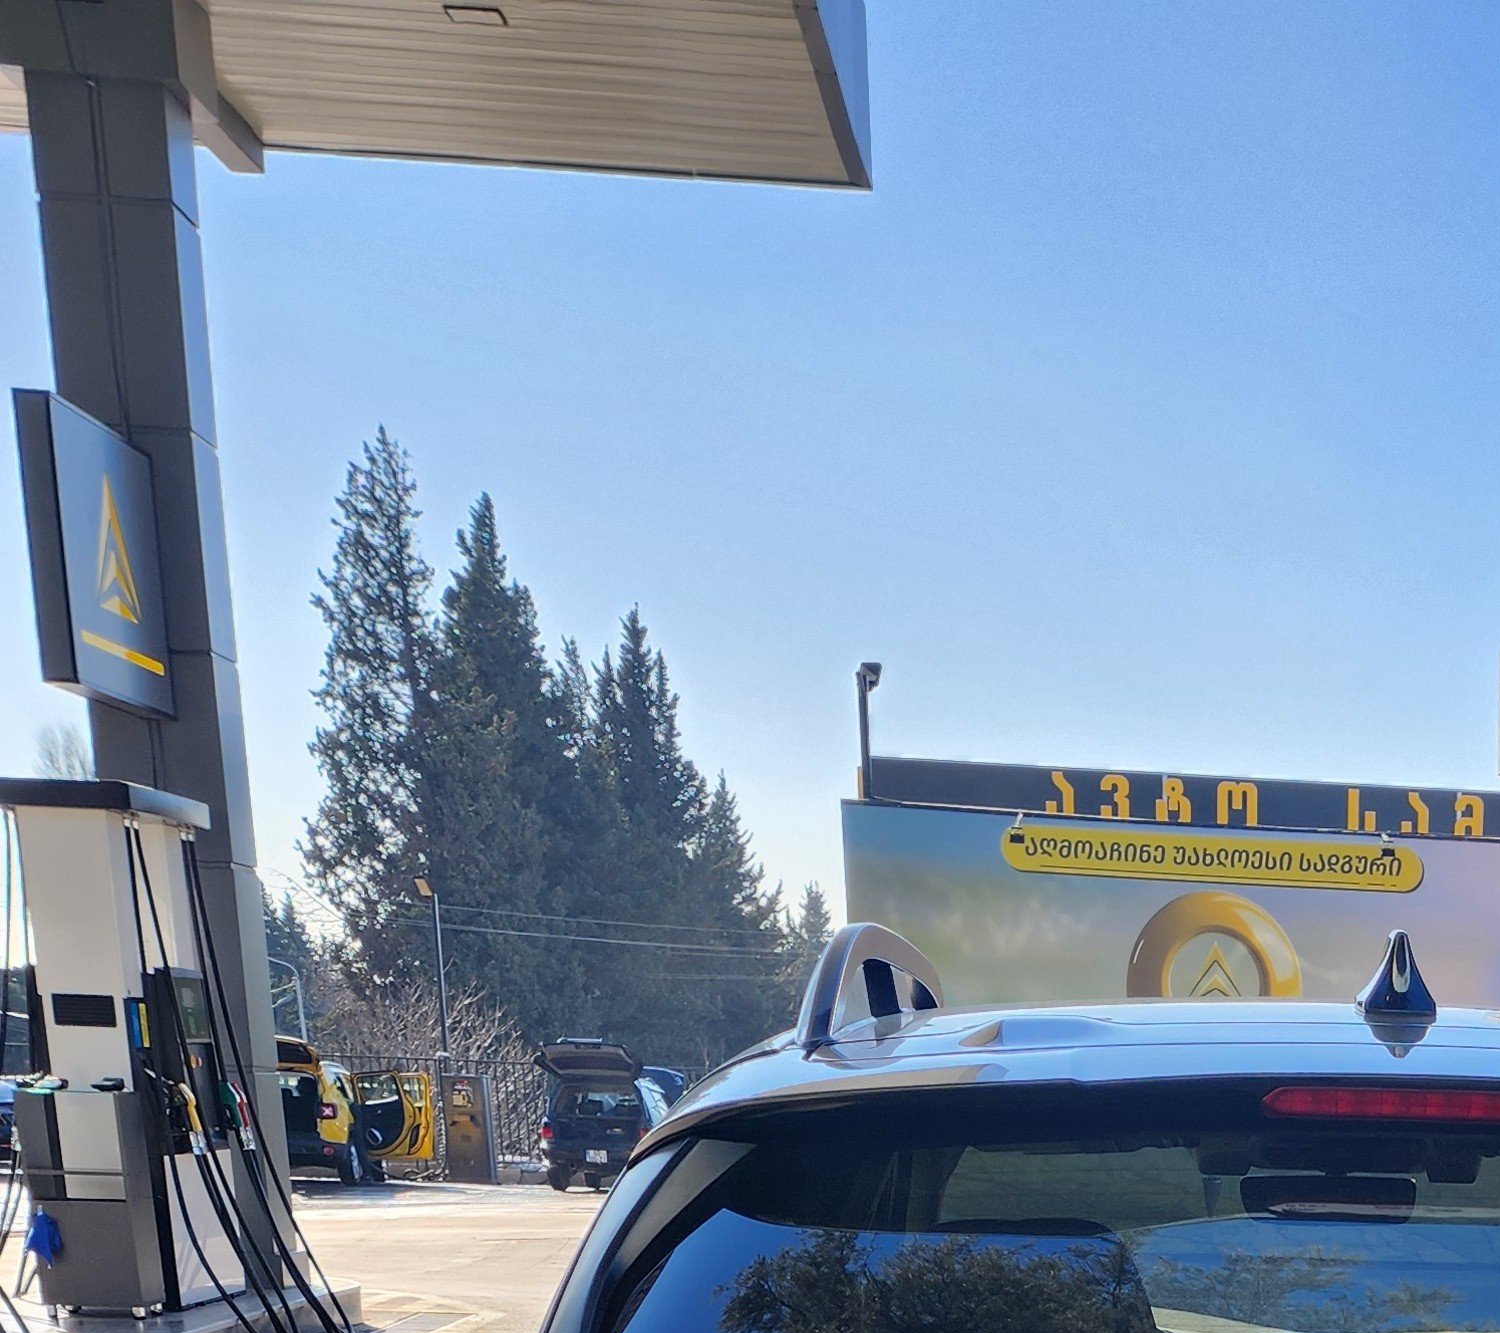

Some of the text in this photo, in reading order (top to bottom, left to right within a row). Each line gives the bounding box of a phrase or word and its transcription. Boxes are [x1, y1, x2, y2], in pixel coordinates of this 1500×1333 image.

[1045, 770, 1258, 827] ავტო
[1024, 835, 1402, 878] აღმოაჩინე უახლოესი სადგური
